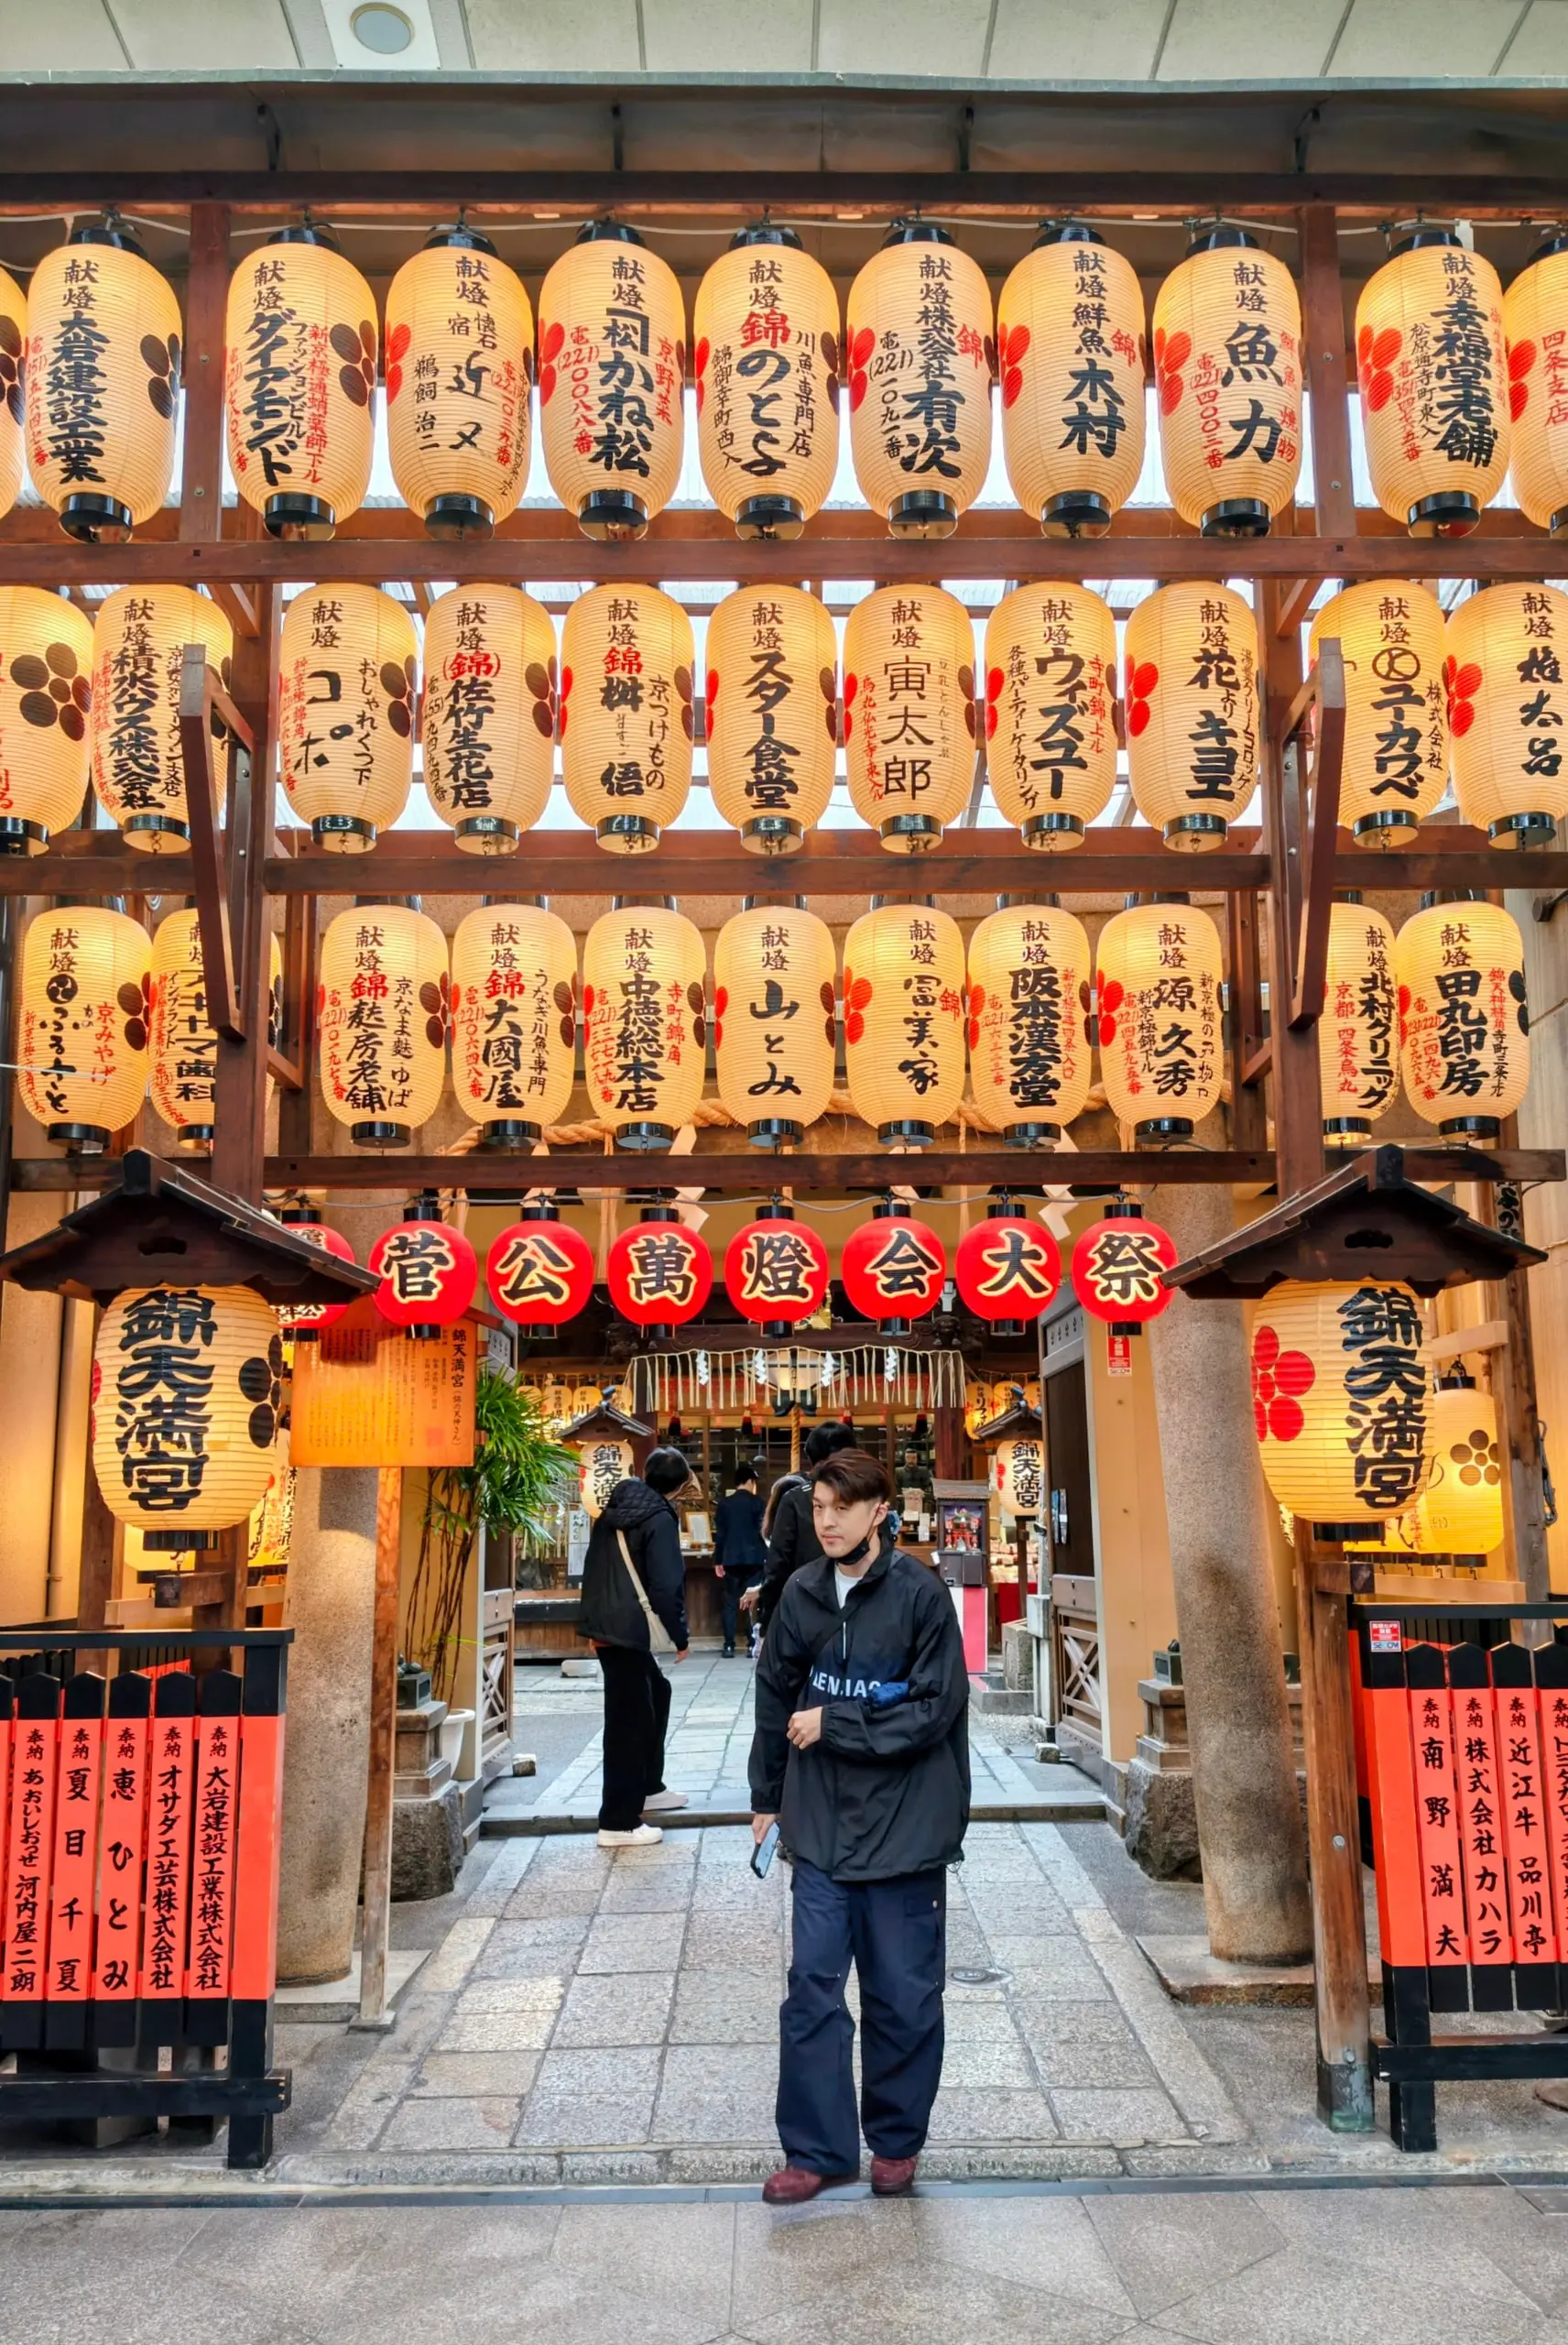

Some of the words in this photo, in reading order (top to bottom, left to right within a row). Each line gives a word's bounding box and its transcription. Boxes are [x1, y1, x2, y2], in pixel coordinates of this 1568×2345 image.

[62, 259, 99, 310] 献燈
[254, 260, 286, 311] 献燈
[455, 256, 490, 307] 献燈
[612, 256, 645, 311] 献燈
[748, 259, 782, 310] 献燈
[920, 254, 953, 307] 献燈
[1073, 249, 1108, 300] 献燈
[1233, 261, 1268, 313] 献燈
[1443, 253, 1477, 300] 献燈
[955, 323, 984, 369] 錦
[1110, 329, 1136, 367] 錦
[46, 311, 111, 484] 大岩建設工業
[243, 309, 298, 485] ダイアモンド
[786, 331, 815, 458] 川魚専門店
[1221, 322, 1282, 464] 魚力
[1431, 300, 1497, 468] 幸福堂老舗
[124, 599, 155, 646] 献燈
[310, 601, 343, 649] 献燈
[456, 603, 487, 650] 献燈
[607, 599, 639, 647] 献燈
[752, 603, 784, 650] 献燈
[891, 599, 923, 649] 献燈
[1041, 599, 1073, 647] 献燈
[1200, 600, 1230, 649] 献燈
[1378, 597, 1411, 644] 献燈
[1522, 593, 1554, 638] 献燈
[107, 645, 165, 810] 積水ハウス株式会社
[294, 671, 354, 774] コポ
[354, 658, 378, 785] おしゃれくつ下
[646, 675, 670, 791] 京つけもの
[742, 651, 800, 809] スター食堂
[881, 655, 934, 801] 寅太郎
[1370, 683, 1425, 799] ユーカワベ
[1426, 680, 1444, 770] 株式会社
[49, 927, 80, 973] 献燈
[355, 926, 385, 971] 献燈
[491, 922, 520, 968] 献燈
[625, 927, 654, 973] 献燈
[761, 925, 789, 971] 献燈
[909, 920, 938, 965] 献燈
[1021, 921, 1051, 965] 献燈
[1158, 923, 1187, 969] 献燈
[1366, 925, 1388, 973] 献燈
[1441, 924, 1472, 967] 献燈
[167, 972, 181, 1050] インプラント
[939, 987, 963, 1021] 錦
[614, 974, 665, 1112] 中徳総本店
[747, 979, 801, 1096] 山とみ
[1007, 965, 1062, 1108] 阪本漢方堂
[1153, 976, 1197, 1096] 源久秀
[1357, 971, 1395, 1109] 北村クリニック
[1434, 970, 1490, 1097] 田丸印房
[384, 1232, 450, 1300] 菅
[498, 1236, 572, 1303] 公
[630, 1234, 696, 1303] 萬
[745, 1233, 817, 1300] 燈
[869, 1229, 942, 1295] 会
[981, 1230, 1053, 1298] 大
[1092, 1233, 1164, 1301] 祭
[115, 1289, 218, 1511] 錦天満宮
[1337, 1287, 1426, 1509] 錦天満宮
[1012, 1442, 1041, 1508] 錦天満宮
[1421, 1697, 1440, 1729] 奉納
[1465, 1696, 1484, 1729] 奉納
[1509, 1696, 1527, 1728] 奉納
[26, 1729, 44, 1761] 奉納
[71, 1728, 90, 1760] 奉納
[117, 1727, 135, 1759] 奉納
[163, 1726, 181, 1758] 奉納
[209, 1726, 228, 1757] 奉納
[1421, 1737, 1462, 1958] 南野満夫
[55, 1766, 92, 1992] 夏目千夏
[103, 1767, 136, 1991] 恵ひとみ
[148, 1764, 183, 1991] オサダ工芸株式会社
[194, 1766, 231, 1991] 大岩建設工業株式会社
